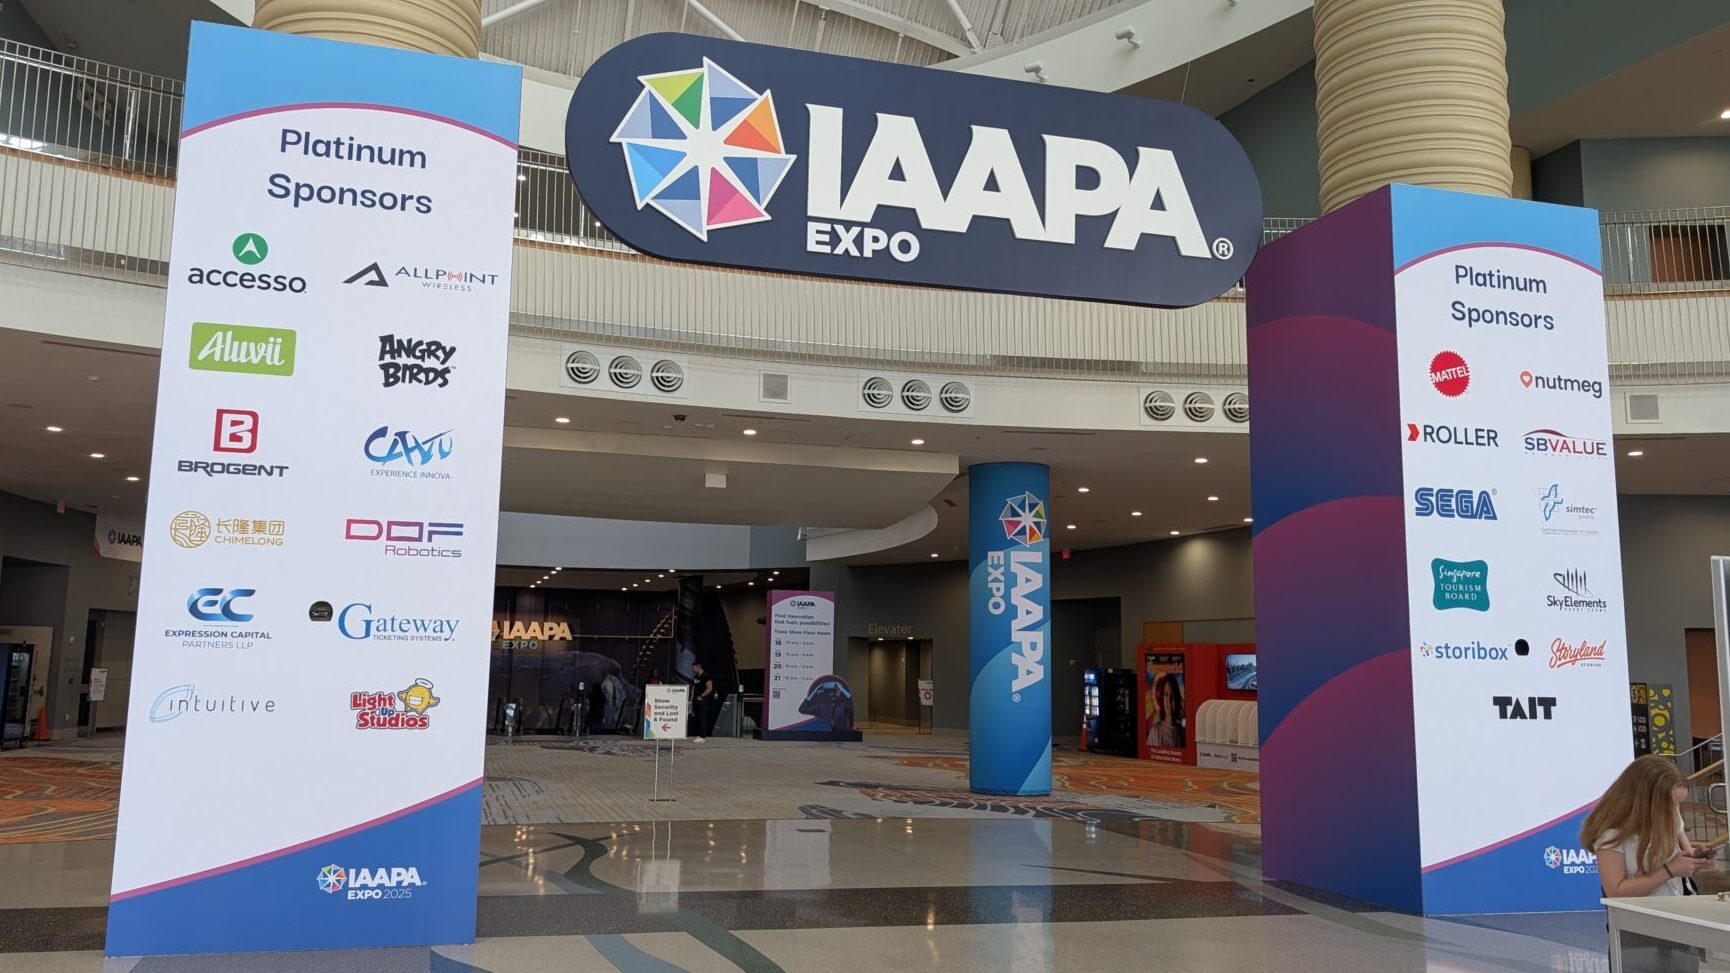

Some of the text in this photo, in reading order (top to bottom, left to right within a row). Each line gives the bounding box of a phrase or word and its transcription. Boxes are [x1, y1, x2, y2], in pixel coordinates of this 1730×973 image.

[280, 128, 426, 168] Platinum
[267, 173, 432, 214] Sponsors
[806, 222, 920, 263] EXPO
[421, 282, 472, 292] WIRELESS
[1455, 264, 1547, 294] Platinum
[1451, 300, 1555, 330] Sponsors
[198, 331, 285, 365] Aluvii
[378, 334, 457, 365] ANGRY
[1430, 365, 1471, 383] MATTEL
[1535, 374, 1602, 399] nutmeg
[1423, 425, 1499, 447] ROLLER
[177, 460, 289, 477] BROGENT
[370, 469, 418, 479] EXPERIENCE
[1565, 504, 1596, 514] simtec
[216, 518, 285, 536] 长隆集团
[345, 518, 464, 543] DOF
[118, 532, 142, 546] IAAPA
[214, 536, 284, 546] CHIMELONG
[385, 545, 462, 558] Robotics
[1439, 565, 1481, 582] Singapore
[987, 551, 1006, 615] EXPO
[1440, 583, 1482, 592] TOURISM
[1445, 592, 1477, 601] BOARD
[338, 603, 460, 641] Gateway
[502, 621, 573, 641] IAAPA
[869, 623, 912, 634] Elevator
[165, 630, 272, 639] EXPRESSION CAPITAL
[182, 640, 254, 649] PARTNERS LLP
[502, 640, 538, 650] EXPO
[1435, 640, 1509, 661] storibox
[169, 694, 276, 713] intuitive
[351, 691, 395, 710] Light
[1493, 696, 1556, 720] TAIT
[357, 711, 429, 729] Studios
[381, 707, 395, 717] Up
[1563, 866, 1585, 874] EXPO
[348, 888, 412, 900] EXPO 2025
